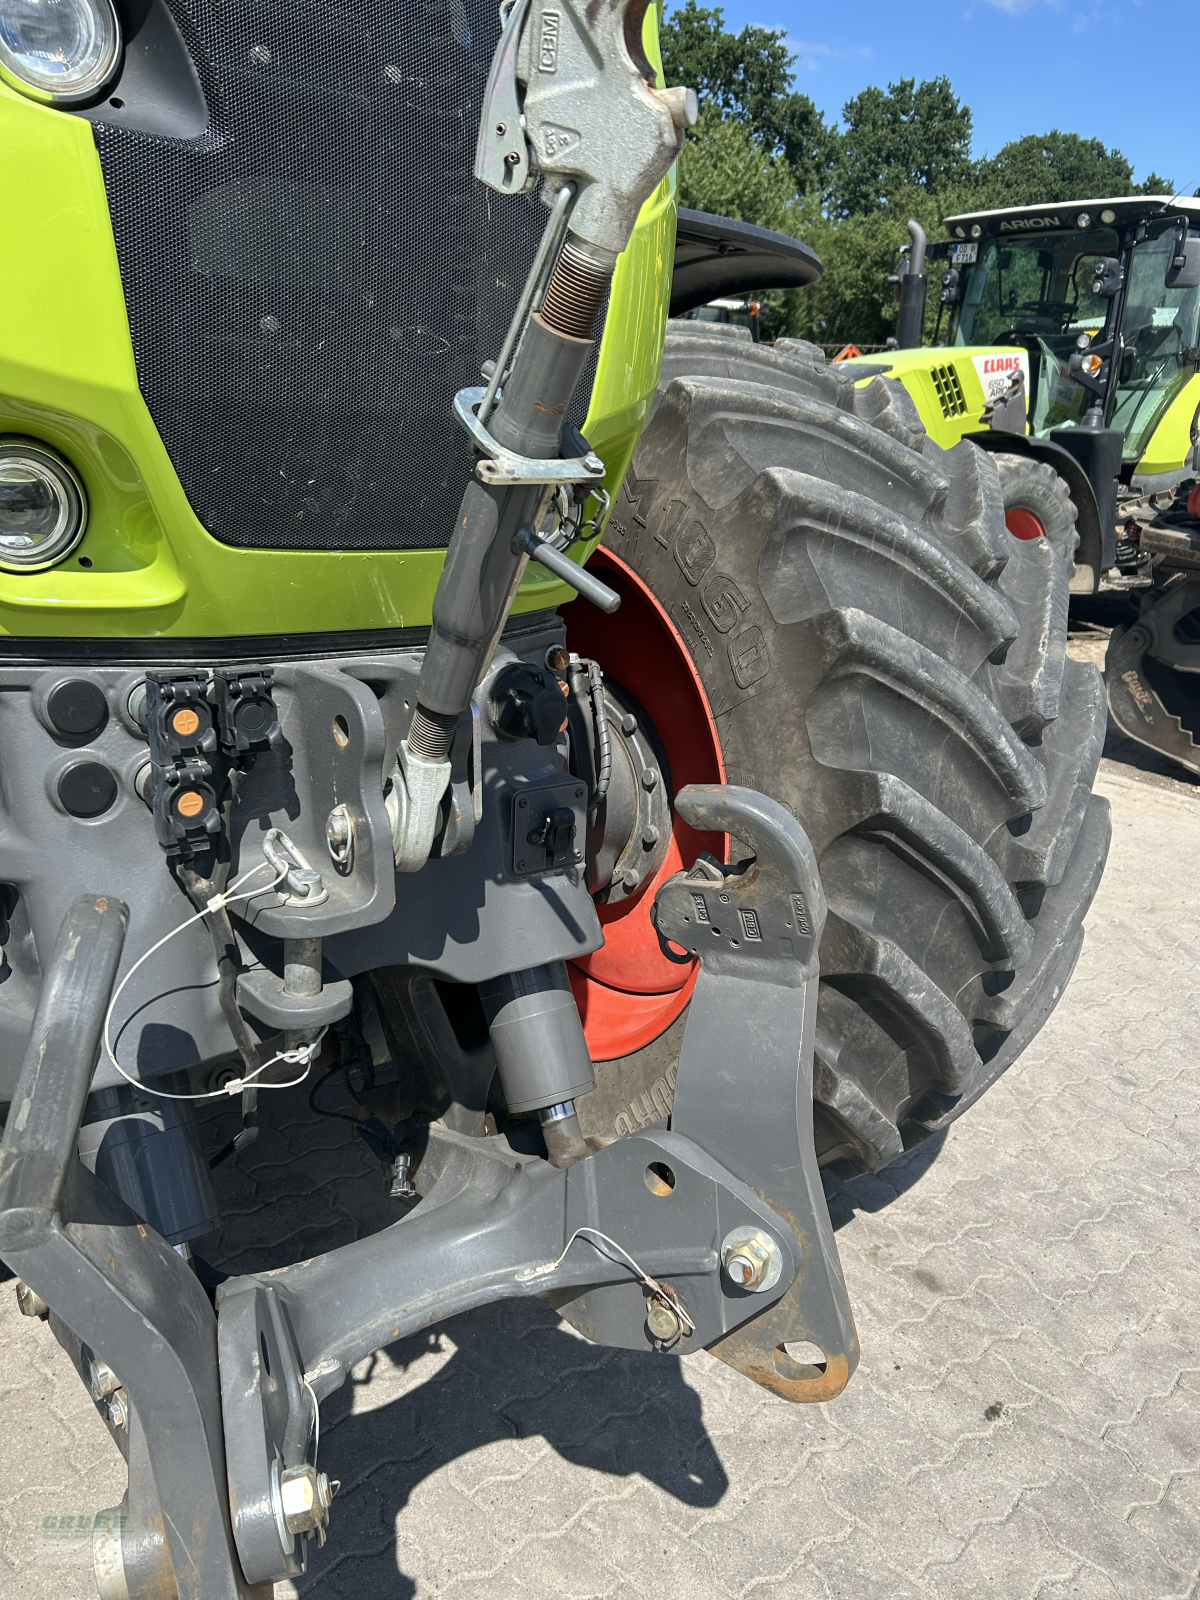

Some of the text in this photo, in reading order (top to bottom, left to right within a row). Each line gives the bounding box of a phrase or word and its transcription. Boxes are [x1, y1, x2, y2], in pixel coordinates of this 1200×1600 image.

[541, 16, 560, 68] CBM
[1000, 216, 1061, 231] ARION
[961, 253, 973, 262] 716
[983, 357, 1020, 374] CLAAS
[988, 378, 1005, 390] 650
[681, 600, 715, 659] RADIAL
[745, 910, 759, 937] CBM
